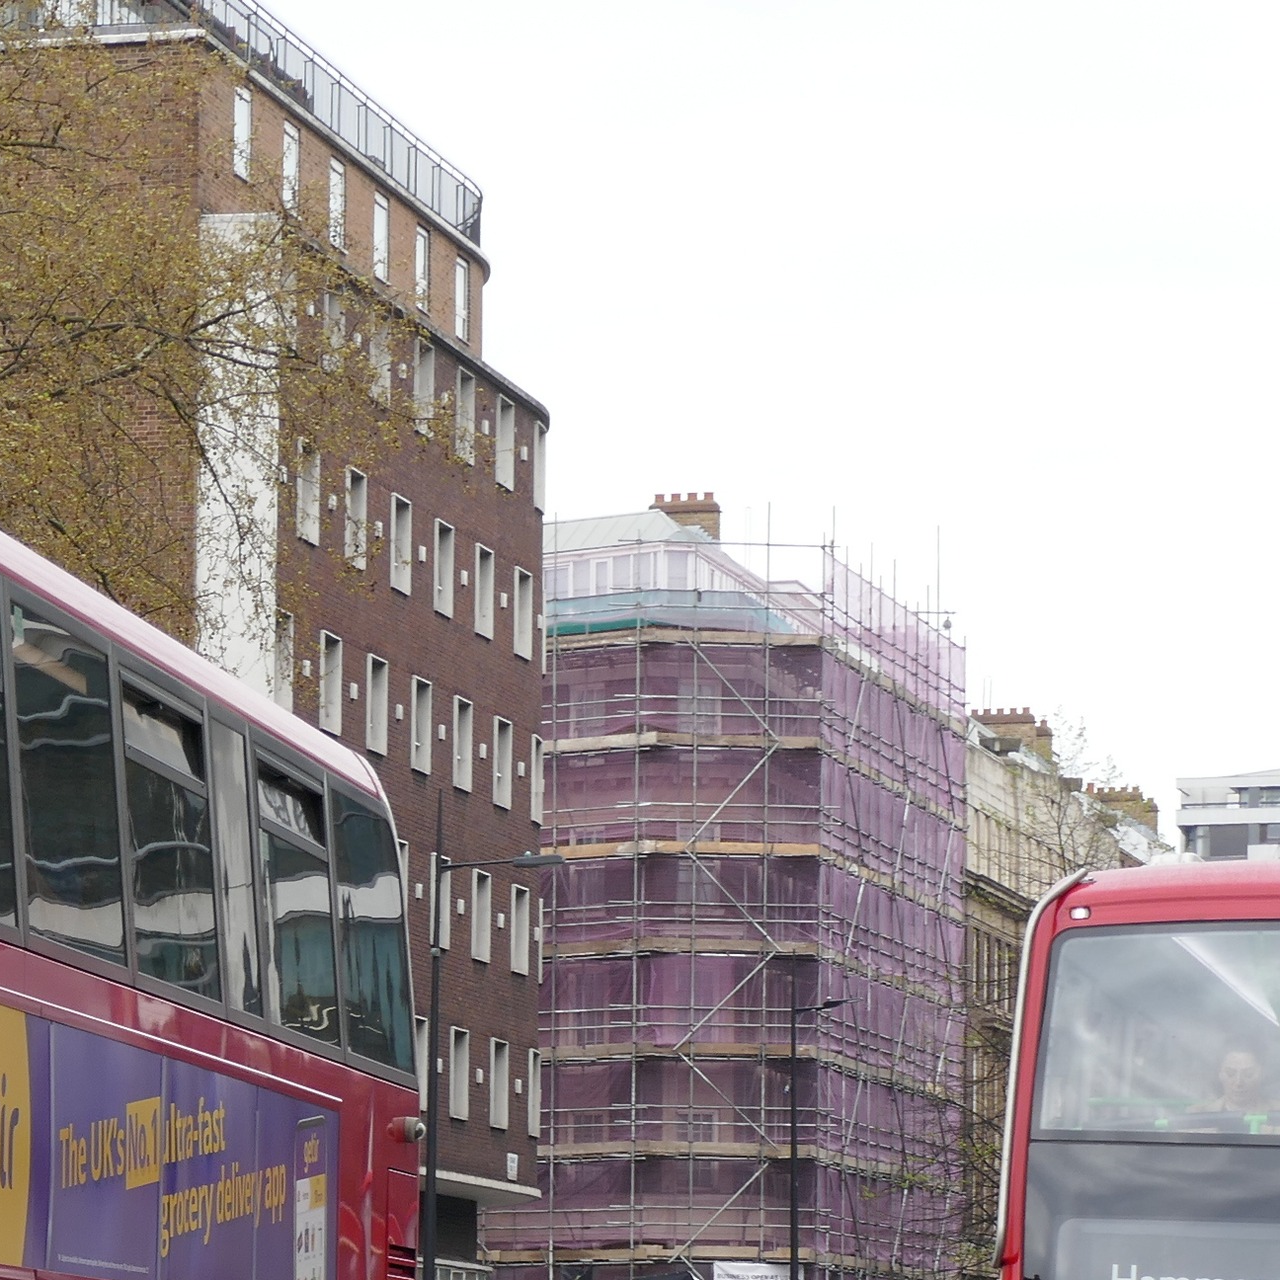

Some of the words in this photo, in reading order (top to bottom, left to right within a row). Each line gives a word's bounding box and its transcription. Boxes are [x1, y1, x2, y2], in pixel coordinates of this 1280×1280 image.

[59, 1123, 87, 1189] The
[91, 1117, 125, 1182] UK's
[126, 1107, 160, 1175] No.1
[163, 1096, 226, 1164] ultra-fast
[303, 1132, 320, 1173] getir
[160, 1182, 214, 1258] grocery
[216, 1161, 263, 1229] delivery
[265, 1163, 287, 1224] app
